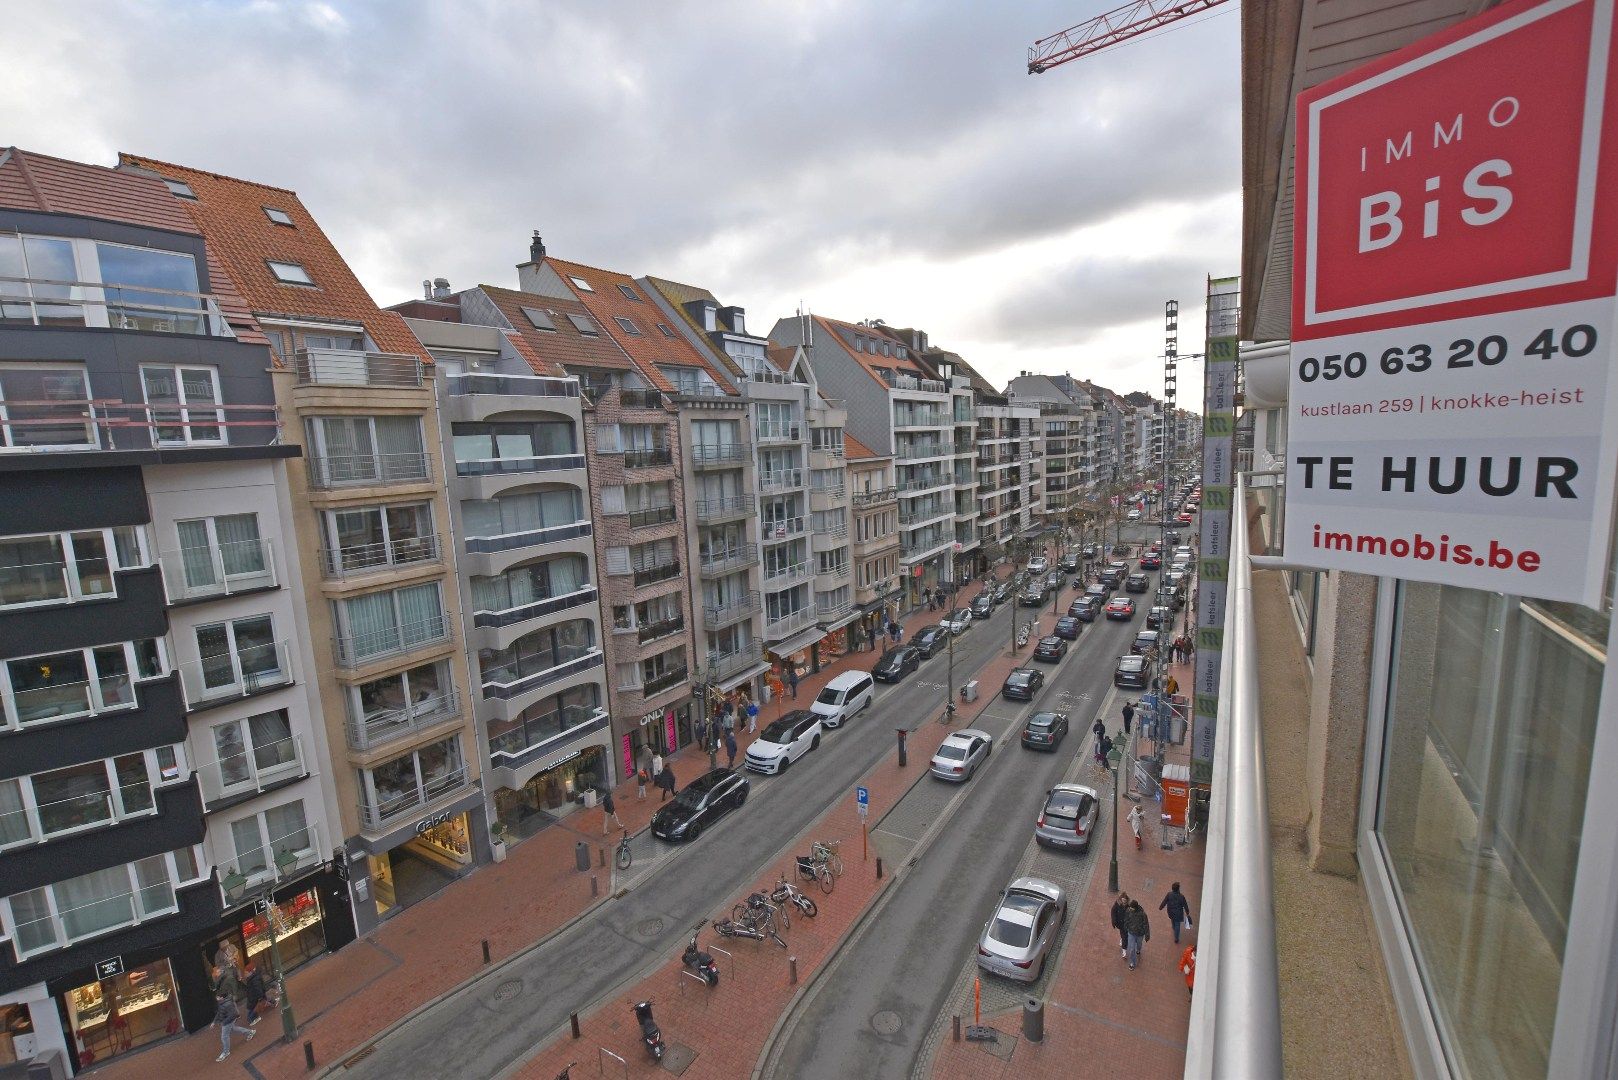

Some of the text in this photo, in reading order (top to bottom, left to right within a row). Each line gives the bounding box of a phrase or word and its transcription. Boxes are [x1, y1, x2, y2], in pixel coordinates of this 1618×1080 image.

[1360, 96, 1520, 172] IMMO
[1358, 158, 1514, 254] BiS
[1298, 324, 1598, 382] 050 63 20 40
[1301, 401, 1373, 417] kustlaan
[1379, 398, 1413, 413] 259
[1431, 388, 1584, 411] knokke-heist
[1212, 448, 1222, 483] batsleer
[1296, 456, 1579, 499] TE HUUR
[1209, 521, 1219, 555] batsleer
[1313, 524, 1541, 572] immobis.be
[1207, 592, 1216, 625] batsleer
[639, 706, 665, 726] ONLY
[858, 789, 866, 801] P
[415, 811, 450, 833] Gabor
